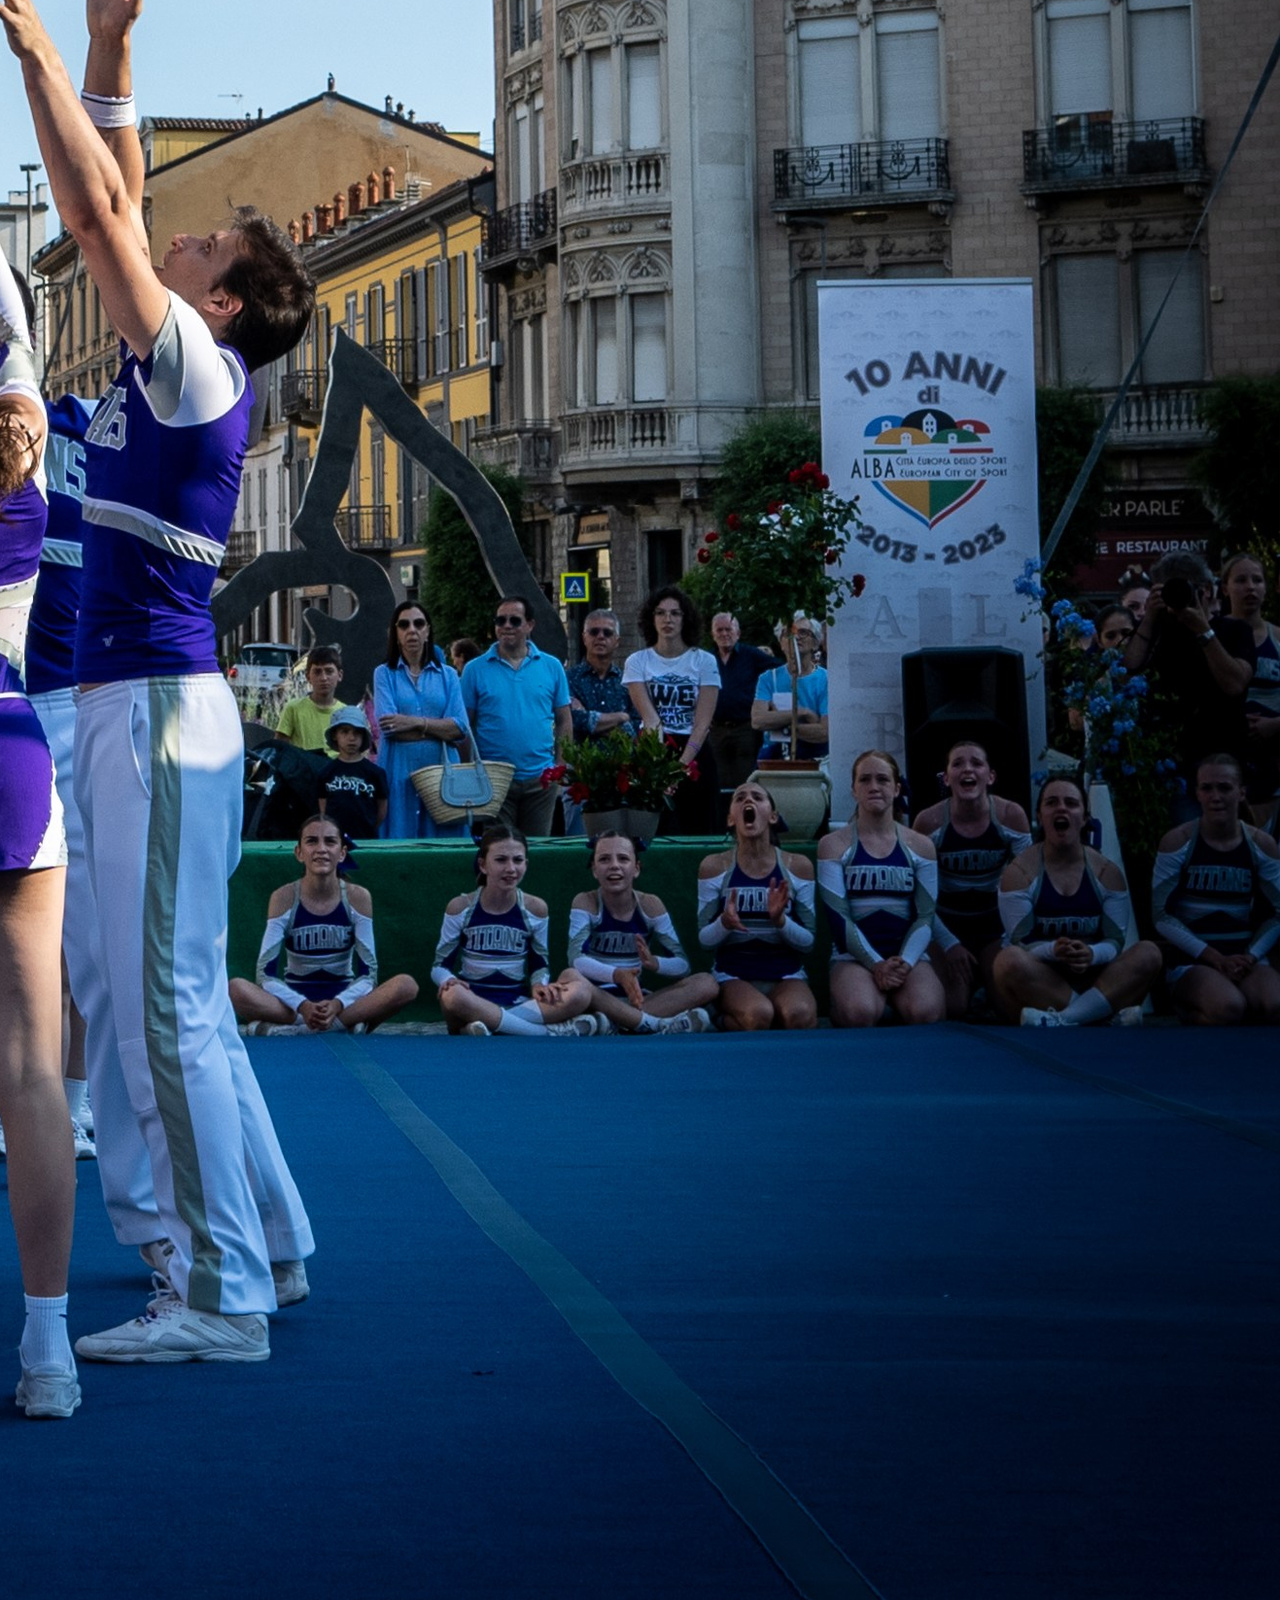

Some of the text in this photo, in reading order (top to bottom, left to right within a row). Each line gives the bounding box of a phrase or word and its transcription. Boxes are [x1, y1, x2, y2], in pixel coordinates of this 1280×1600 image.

[844, 351, 1007, 396] 10 ANNI
[918, 385, 940, 405] di
[851, 458, 896, 479] ALBA
[855, 525, 918, 563] 2013
[942, 523, 1007, 565] 2023
[1116, 540, 1209, 554] RESTAURANT
[648, 683, 695, 707] WE
[845, 865, 915, 891] TITANS
[1186, 865, 1252, 892] TITANS
[290, 924, 353, 951] TITANS
[463, 924, 529, 953] TITANS
